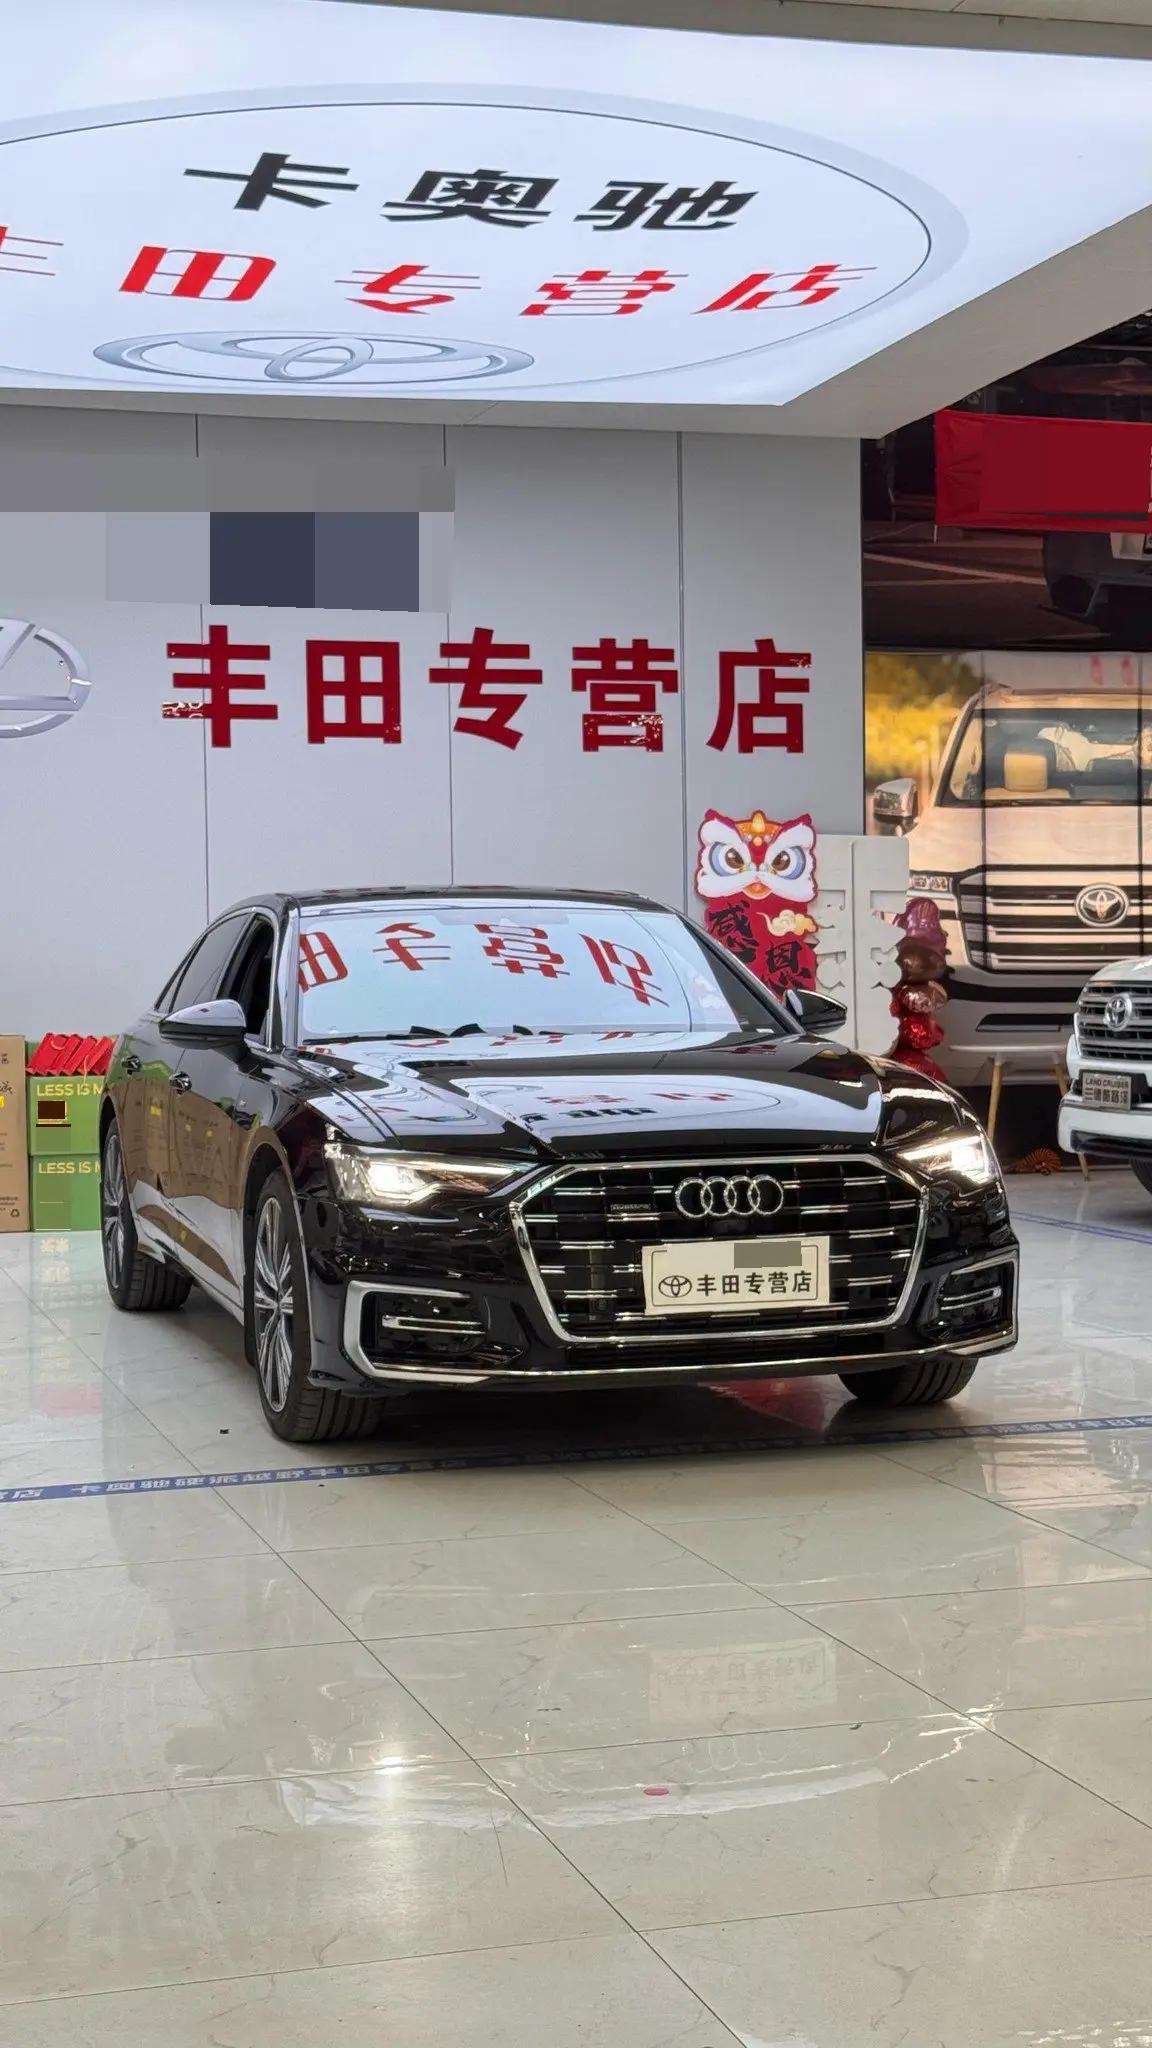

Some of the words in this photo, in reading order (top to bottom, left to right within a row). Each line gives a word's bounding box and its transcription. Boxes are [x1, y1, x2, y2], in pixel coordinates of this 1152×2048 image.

[183, 152, 758, 232] 卡奥驰
[162, 625, 813, 754] 丰田专营店
[36, 1083, 74, 1097] LESS
[77, 1083, 91, 1096] IS
[38, 1161, 75, 1174] LESS
[78, 1160, 92, 1173] IS
[696, 1270, 813, 1298] 丰田专营店
